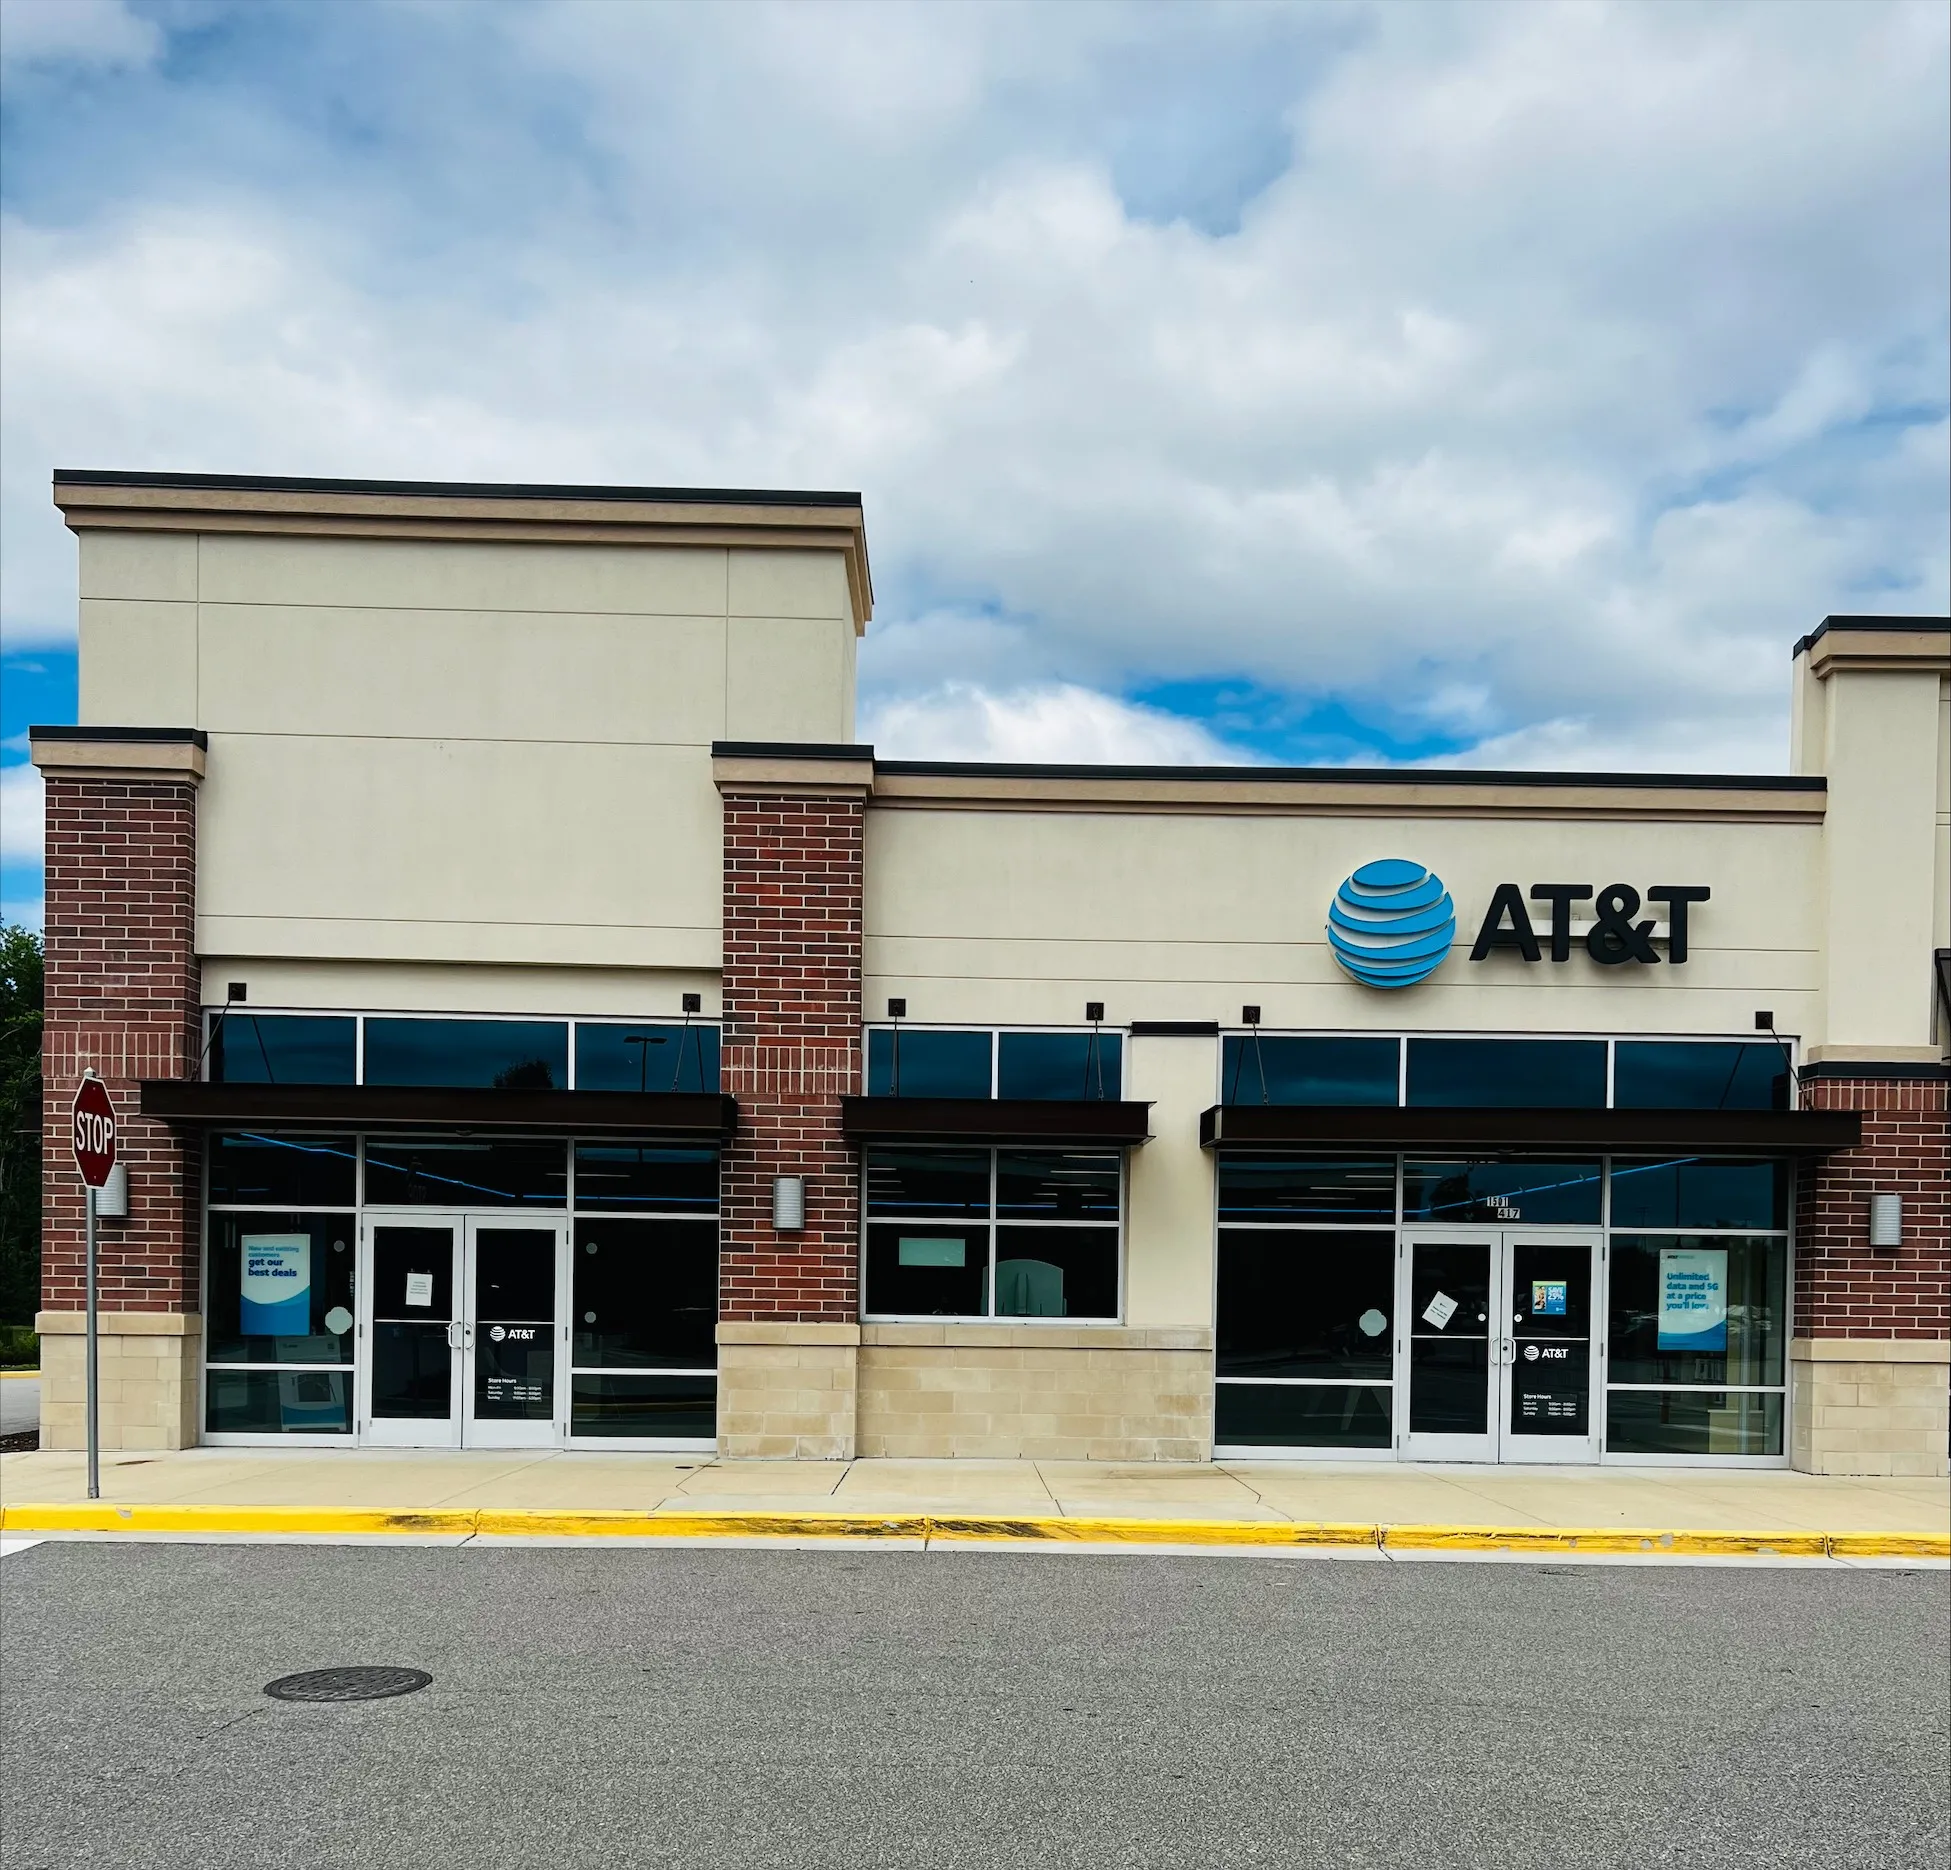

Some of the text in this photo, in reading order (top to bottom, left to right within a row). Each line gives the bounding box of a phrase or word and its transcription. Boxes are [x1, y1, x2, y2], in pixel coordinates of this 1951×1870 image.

[1469, 883, 1711, 964] AT&T
[76, 1110, 114, 1155] STOP
[1487, 1196, 1509, 1207] 1501
[1498, 1208, 1520, 1219] 417
[248, 1259, 265, 1267] get
[248, 1268, 297, 1276] best deals
[1667, 1272, 1710, 1280] Unlimited
[1666, 1281, 1719, 1291] data and 5G
[1685, 1292, 1707, 1302] price
[1666, 1301, 1690, 1311] you'll
[508, 1329, 536, 1339] AT&T
[1541, 1348, 1569, 1358] AT&T
